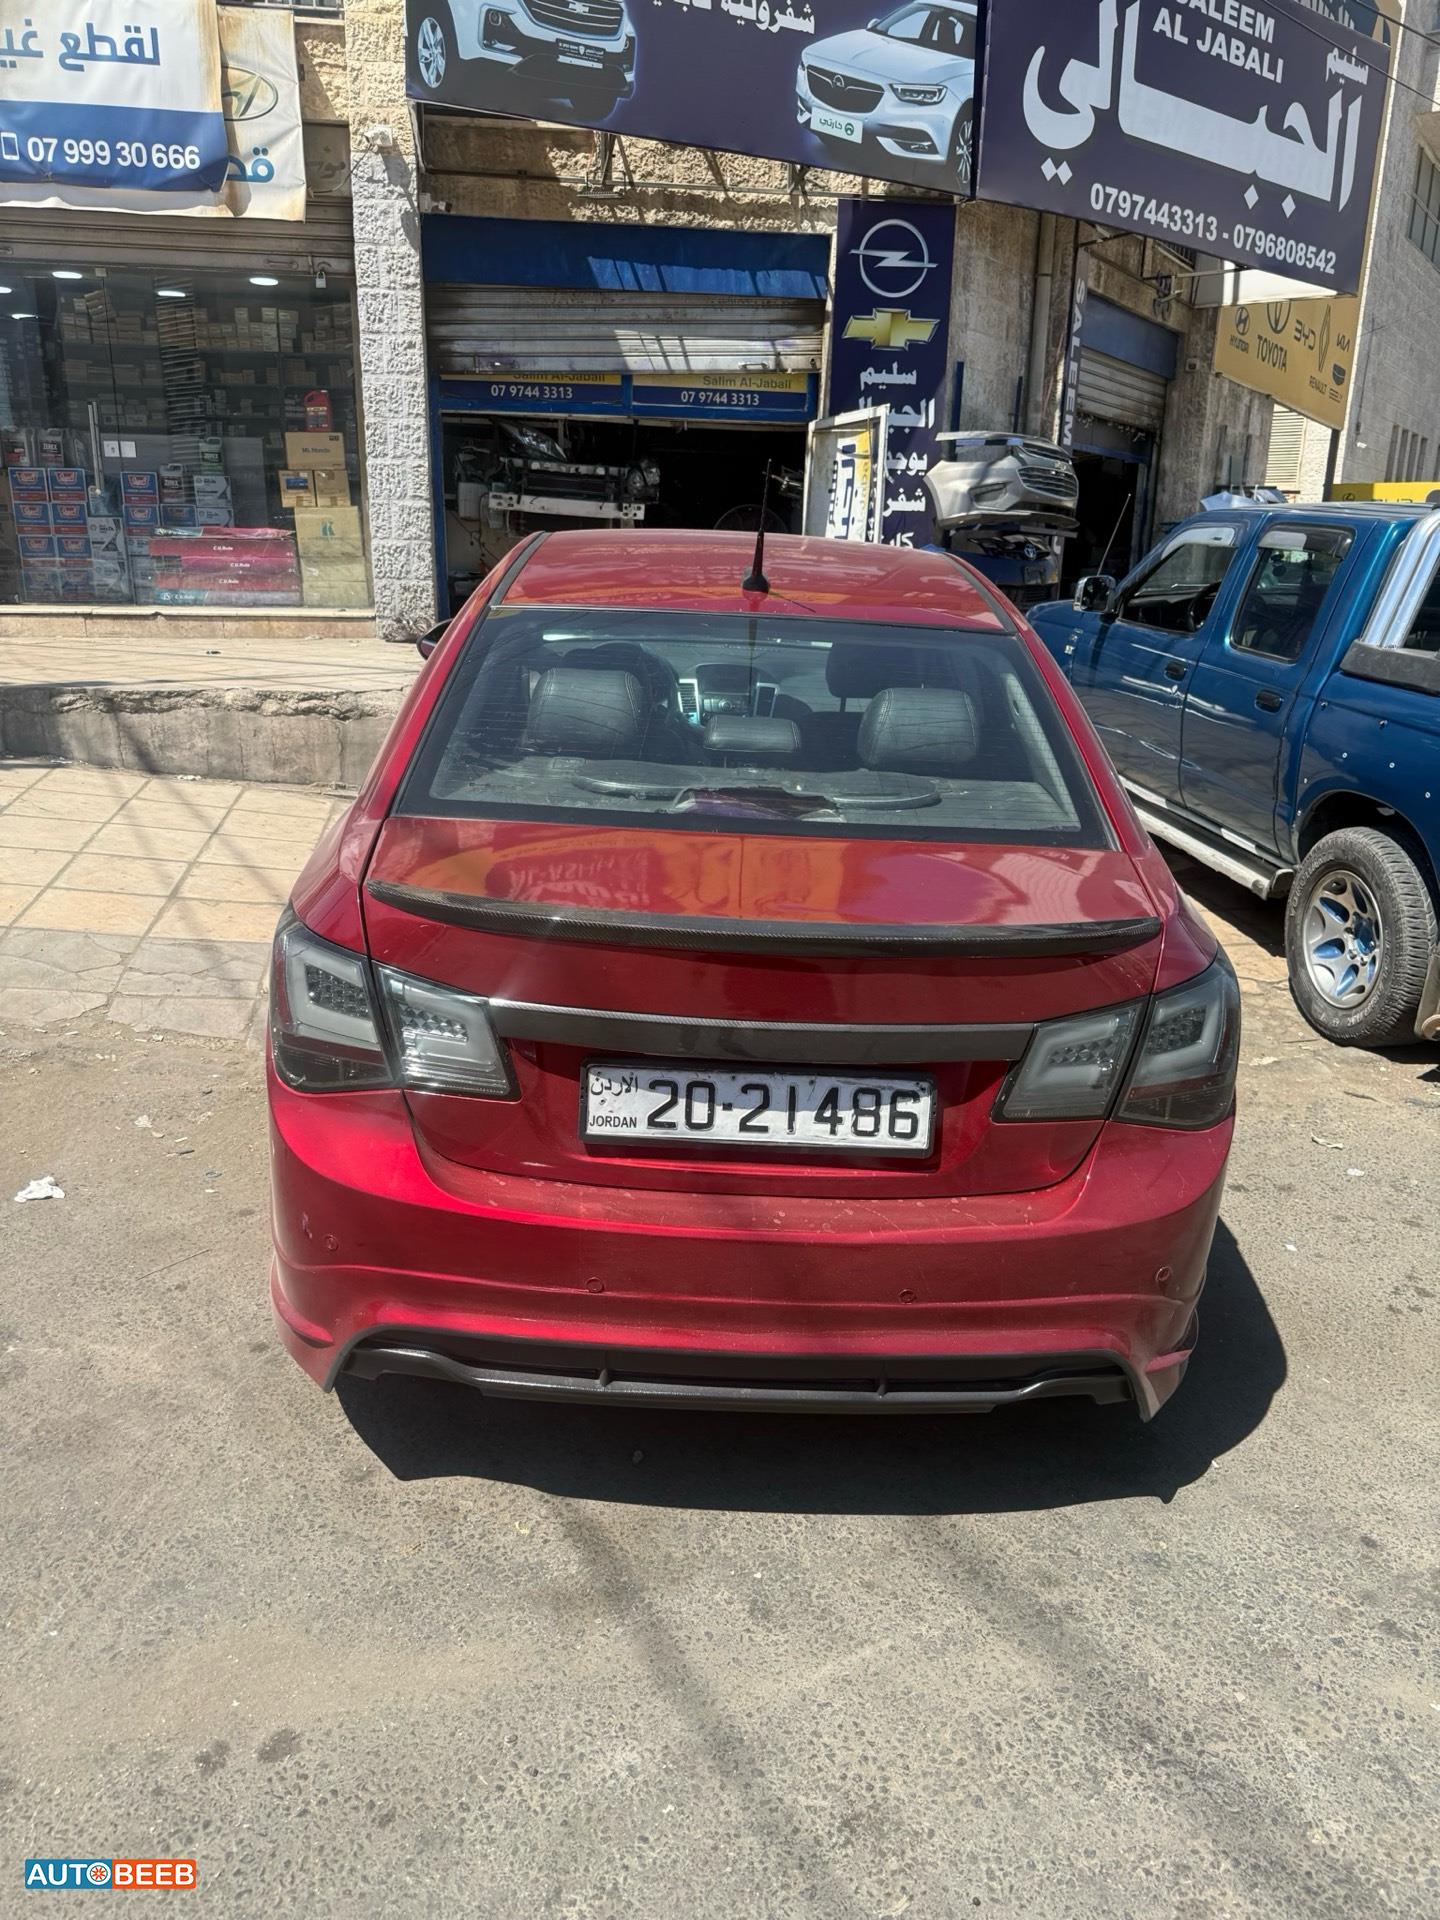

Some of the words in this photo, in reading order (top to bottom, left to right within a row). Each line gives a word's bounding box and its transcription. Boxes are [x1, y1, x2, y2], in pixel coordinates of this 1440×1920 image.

[58, 22, 161, 72] لقطع
[1152, 7, 1189, 45] AL
[1196, 26, 1284, 84] JABALI
[1325, 45, 1369, 85] سليم
[1023, 0, 1362, 219] الجبالي
[27, 137, 58, 162] 07
[63, 138, 111, 166] 999
[116, 141, 148, 168] 30
[151, 143, 201, 170] 666
[1089, 182, 1218, 242] 0797443313
[1233, 223, 1337, 275] 0796808542
[1062, 277, 1086, 446] SALEEM
[1256, 334, 1288, 373] TOYOTA
[491, 384, 506, 397] 07
[509, 385, 540, 398] 9744
[543, 386, 573, 399] 3313
[703, 375, 736, 387] Salim
[860, 360, 917, 391] سليم
[680, 390, 695, 403] 07
[698, 391, 728, 405] 9744
[731, 393, 760, 406] 3313
[589, 1115, 638, 1128] JORDAN
